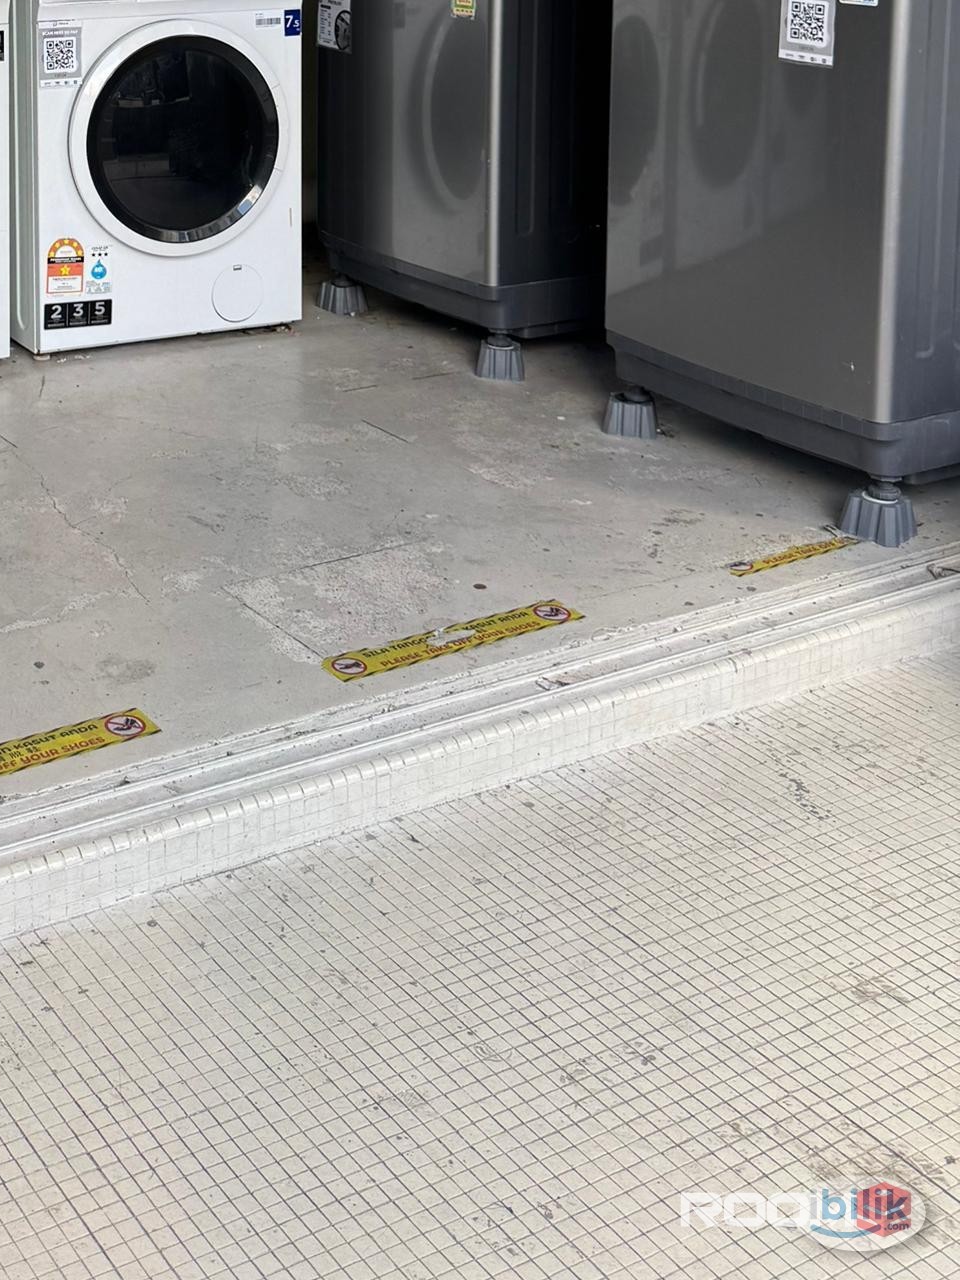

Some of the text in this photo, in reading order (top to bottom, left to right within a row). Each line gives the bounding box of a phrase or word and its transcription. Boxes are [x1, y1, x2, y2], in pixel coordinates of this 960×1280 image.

[50, 301, 105, 319] 2 3 5
[362, 648, 390, 658] SILA
[498, 611, 529, 623] ANDA
[380, 651, 422, 667] PLEASE
[422, 644, 452, 656] TAKE
[474, 629, 505, 641] YOUR
[506, 621, 541, 634] SHOES
[14, 734, 56, 752] KASUT
[60, 724, 98, 738] ANDA
[21, 749, 60, 765] YOUR
[61, 736, 106, 753] SHOES
